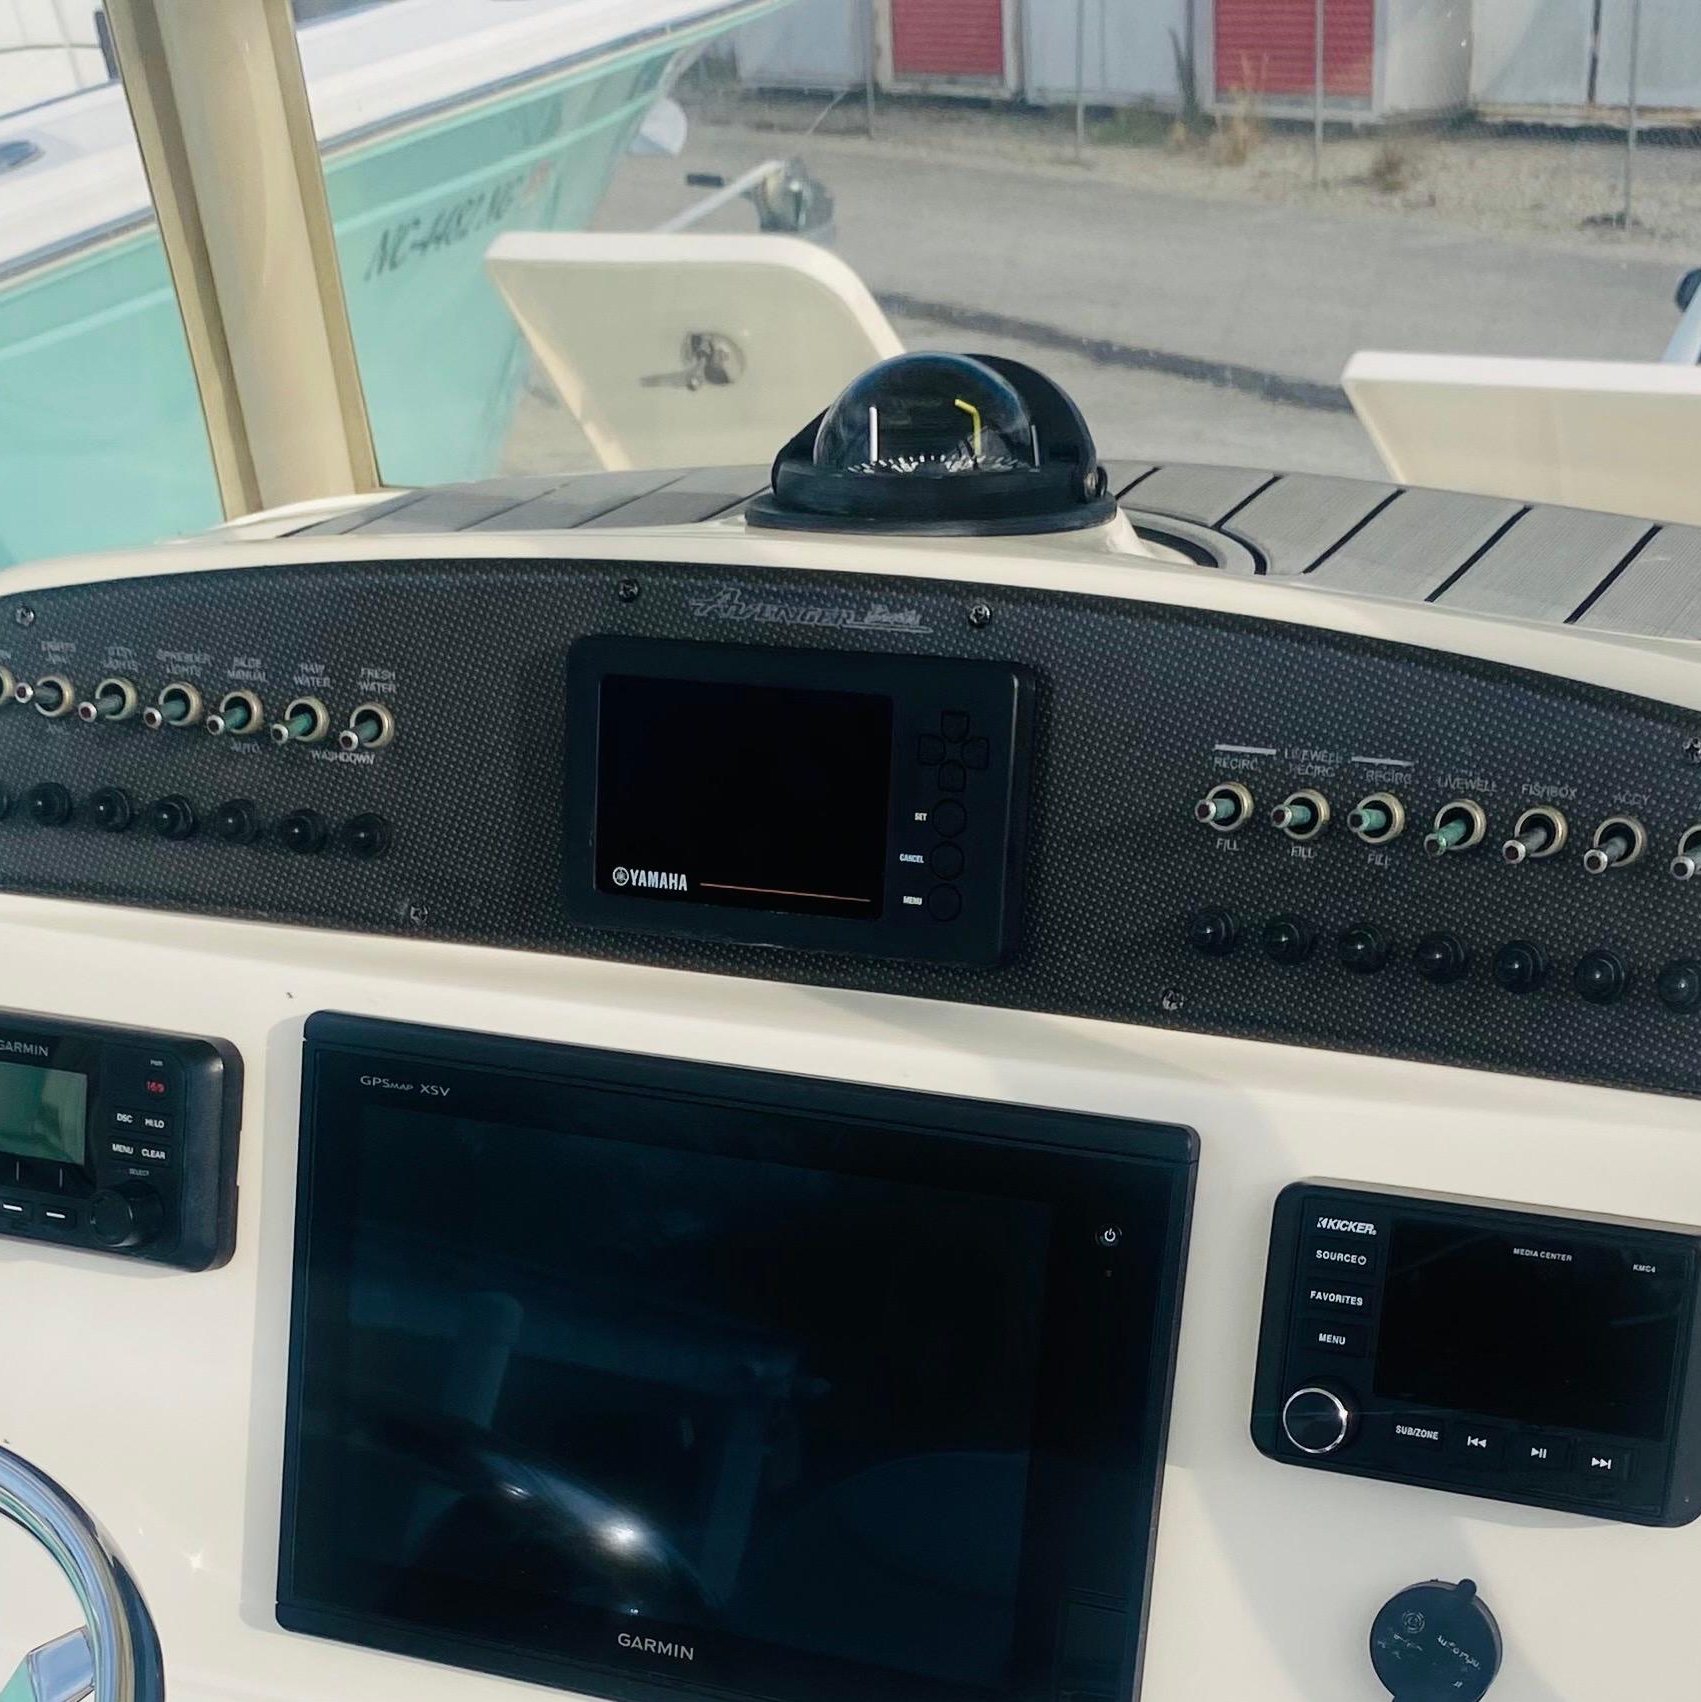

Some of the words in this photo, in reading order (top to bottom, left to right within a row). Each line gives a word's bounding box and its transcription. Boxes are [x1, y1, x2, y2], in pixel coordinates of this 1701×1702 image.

[227, 669, 268, 682] MANUAL
[300, 663, 325, 675] RAW
[360, 667, 395, 680] FRESH
[293, 675, 330, 688] WATER
[359, 681, 396, 693] WATER
[311, 750, 375, 764] WASHDOWN
[1214, 757, 1258, 770] RECIRC
[1366, 770, 1412, 784] RECIRC
[1438, 776, 1498, 792] LIVEWELL
[914, 812, 927, 820] SET
[1216, 838, 1238, 850] FILL
[899, 853, 924, 863] CANCEL
[1291, 846, 1315, 858] FILL
[630, 868, 687, 891] YAMAHA
[420, 1084, 450, 1096] XSV
[116, 1112, 133, 1123] DSC
[112, 1143, 133, 1154] MENU
[141, 1148, 165, 1159] CLEAR
[1326, 1218, 1374, 1234] KICKER
[1316, 1249, 1356, 1263] SOURCE
[1513, 1247, 1538, 1257] MEDIA
[1540, 1251, 1572, 1261] CENTER
[1310, 1290, 1363, 1305] FAVORITES
[1318, 1332, 1345, 1345] MENU
[617, 1632, 693, 1660] GARMIN
